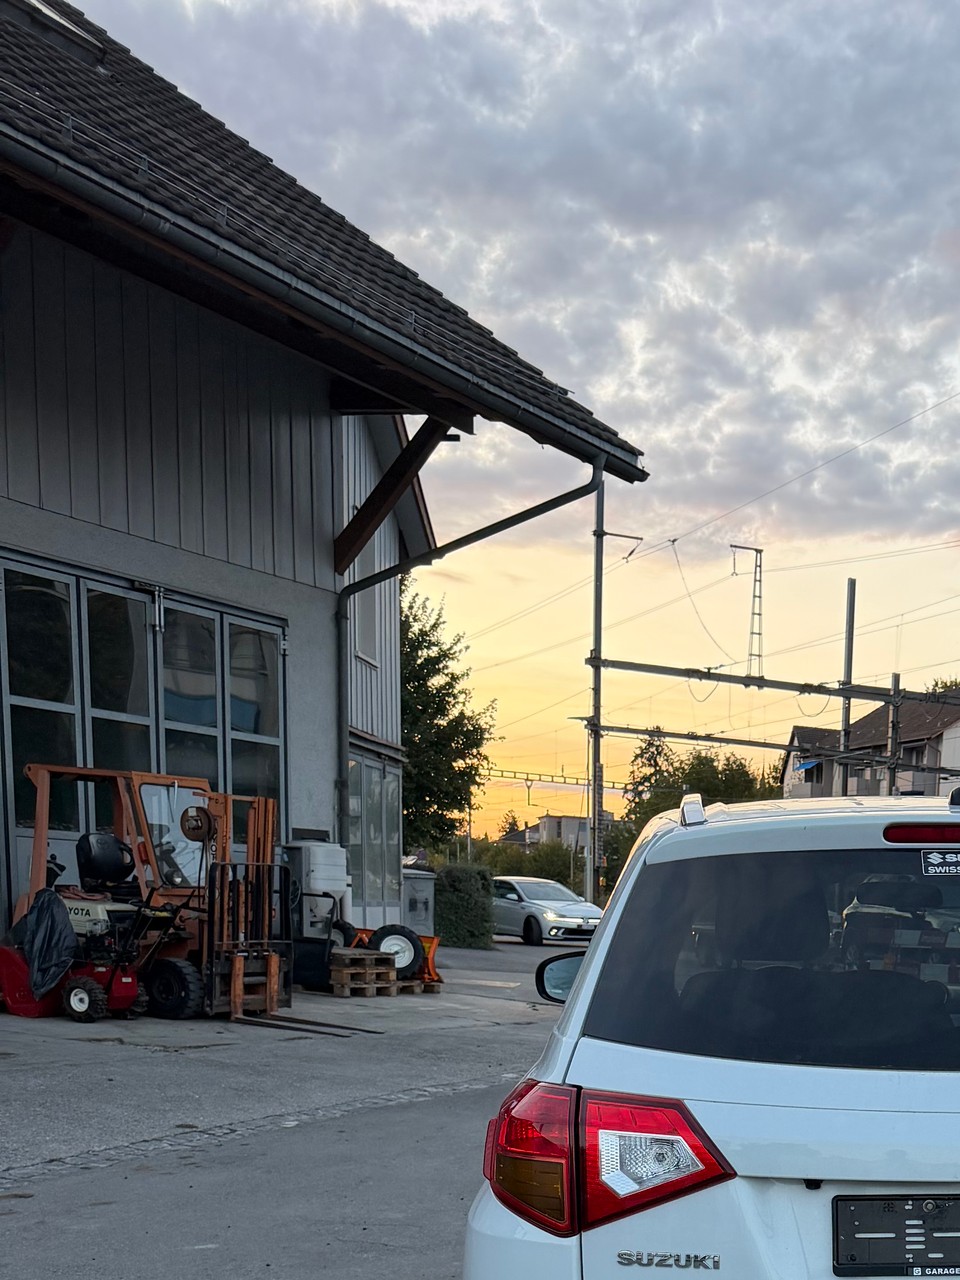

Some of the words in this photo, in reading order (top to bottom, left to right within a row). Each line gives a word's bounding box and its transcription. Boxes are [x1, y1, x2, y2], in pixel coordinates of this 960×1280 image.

[68, 906, 91, 917] YOTA
[617, 1249, 720, 1270] SUZUKI
[925, 1267, 960, 1275] GARAGE
